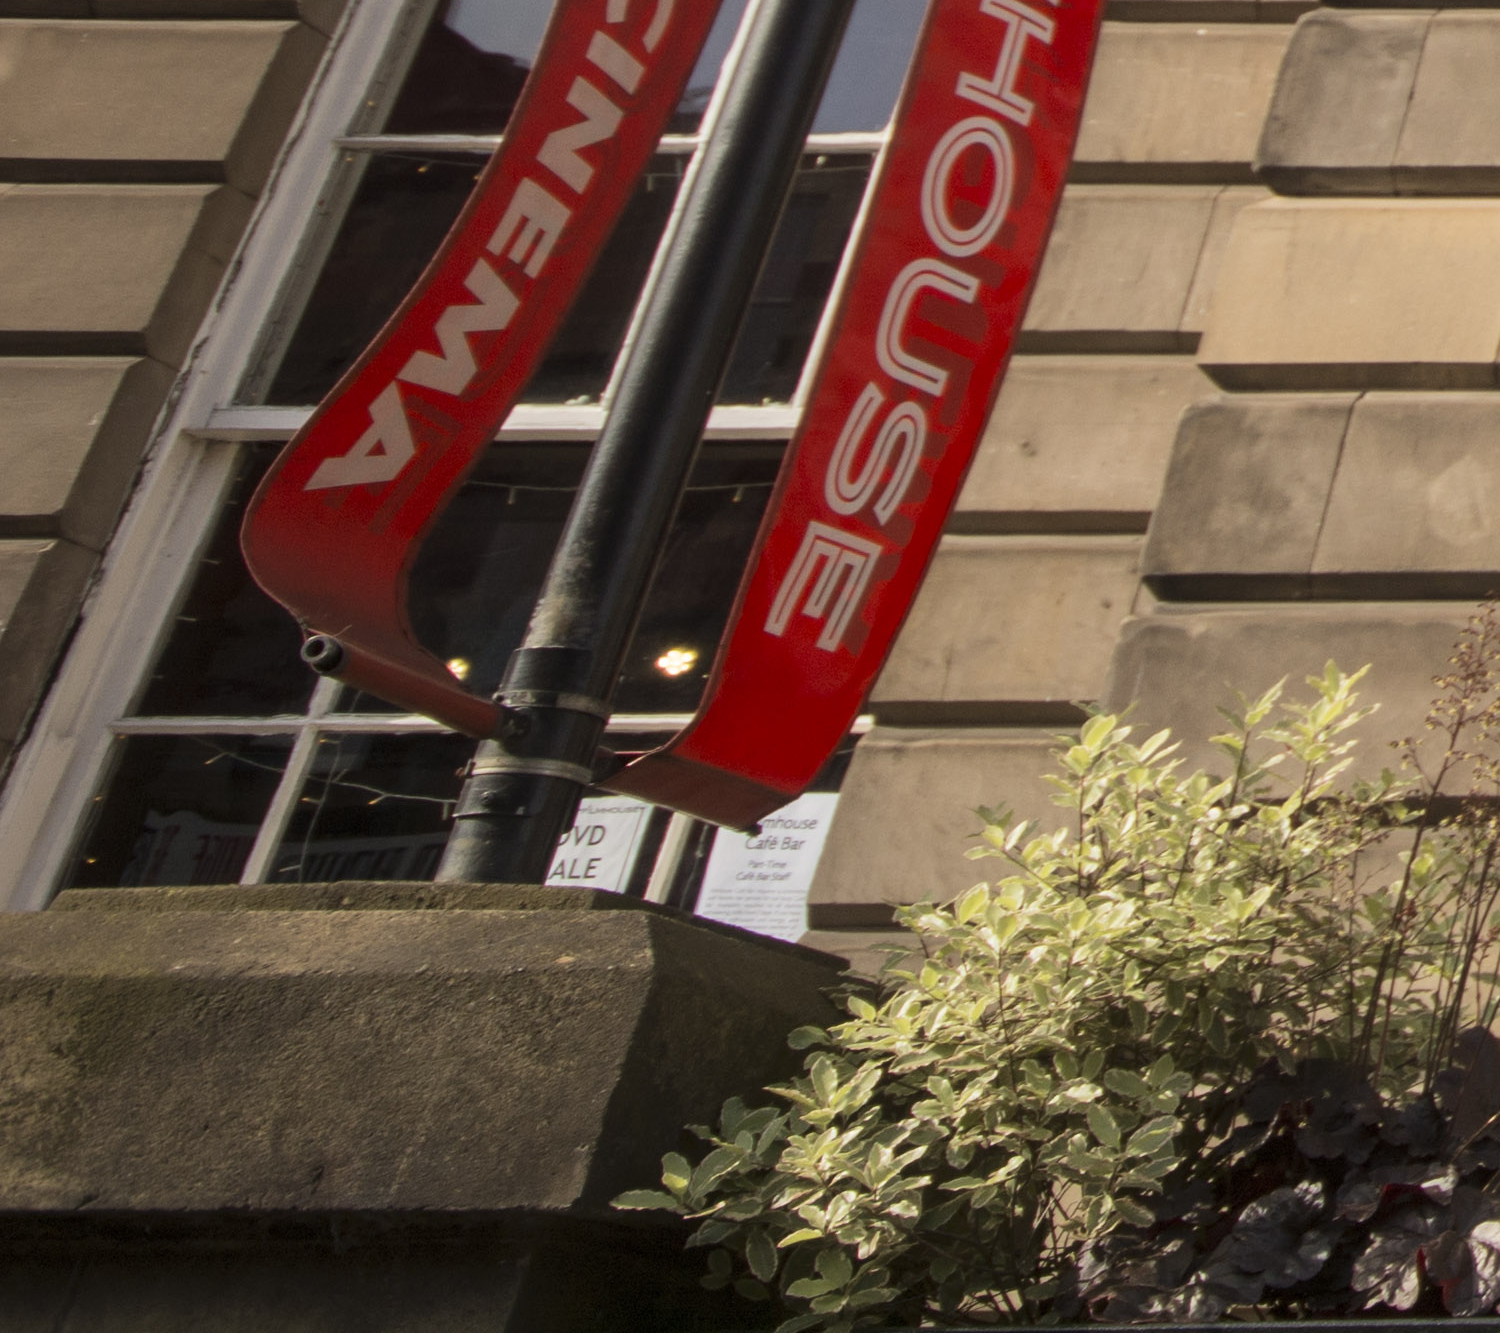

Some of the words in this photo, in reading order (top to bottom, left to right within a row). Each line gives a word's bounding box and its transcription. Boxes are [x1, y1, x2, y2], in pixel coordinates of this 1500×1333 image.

[761, 815, 818, 831] mhouse
[744, 834, 779, 851] Café
[780, 836, 805, 851] Bar
[547, 857, 603, 880] ALE
